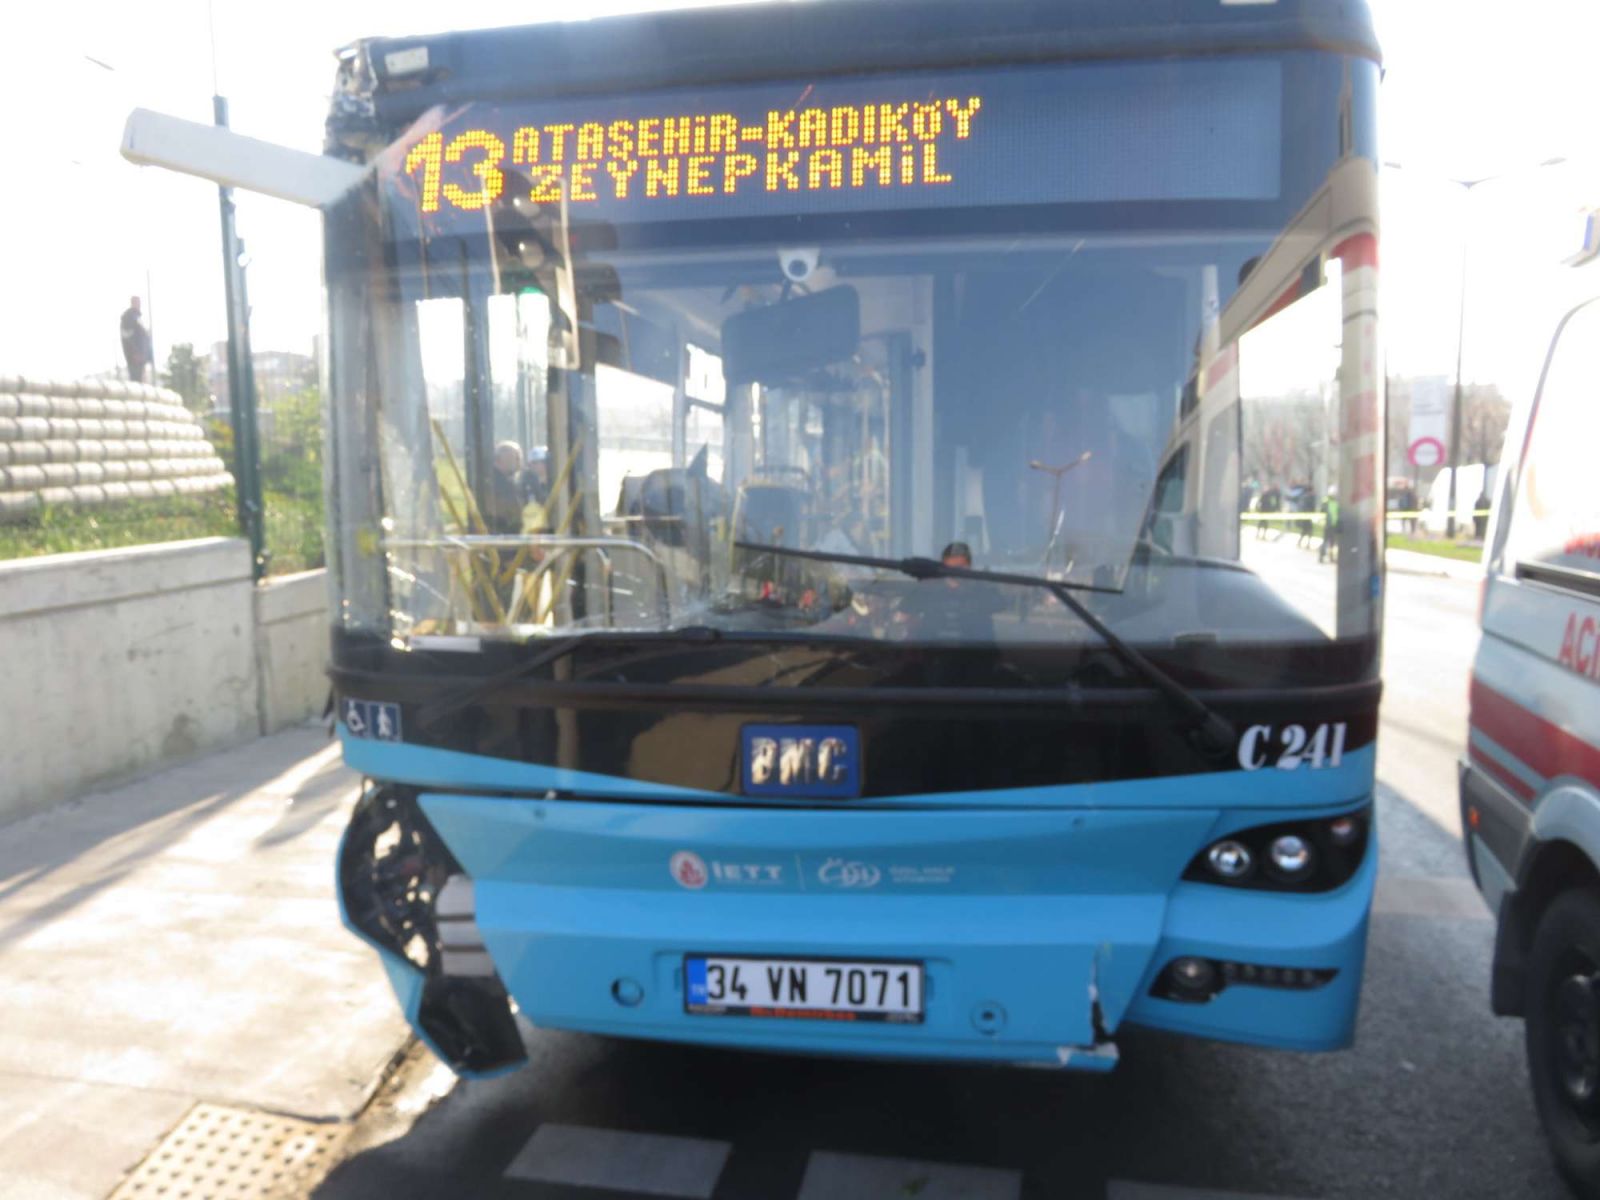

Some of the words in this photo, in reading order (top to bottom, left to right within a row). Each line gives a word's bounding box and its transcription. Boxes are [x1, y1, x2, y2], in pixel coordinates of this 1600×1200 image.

[405, 131, 505, 213] 13
[751, 736, 848, 785] BMC
[1237, 723, 1272, 771] C
[1275, 721, 1347, 771] 241
[707, 964, 748, 1001] 34
[766, 965, 807, 1004] VN
[824, 967, 910, 1008] 7071
